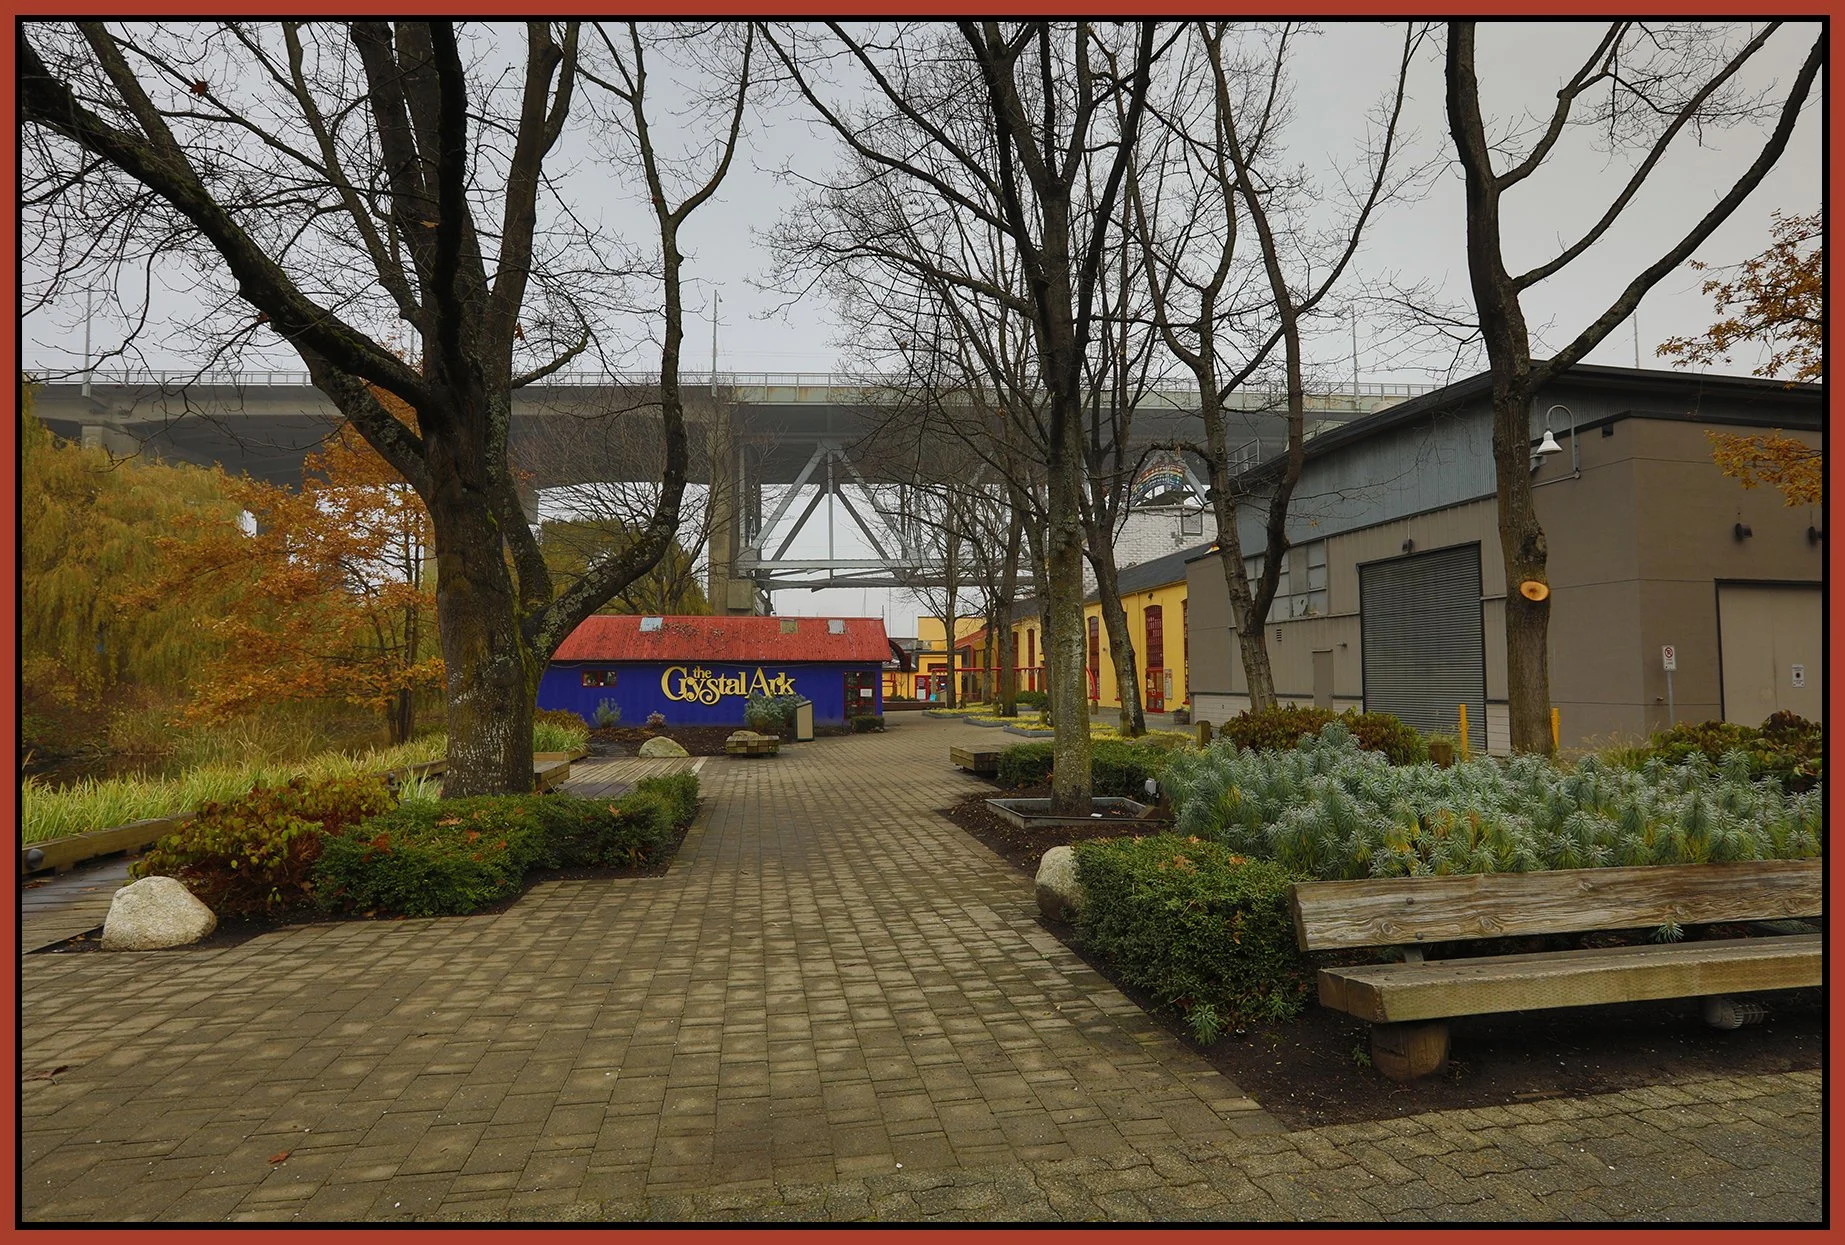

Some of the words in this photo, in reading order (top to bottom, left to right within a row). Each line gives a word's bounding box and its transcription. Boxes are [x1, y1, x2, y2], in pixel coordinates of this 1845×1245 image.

[661, 666, 748, 705] Crystal
[744, 666, 797, 699] Ark
[693, 666, 712, 679] the
